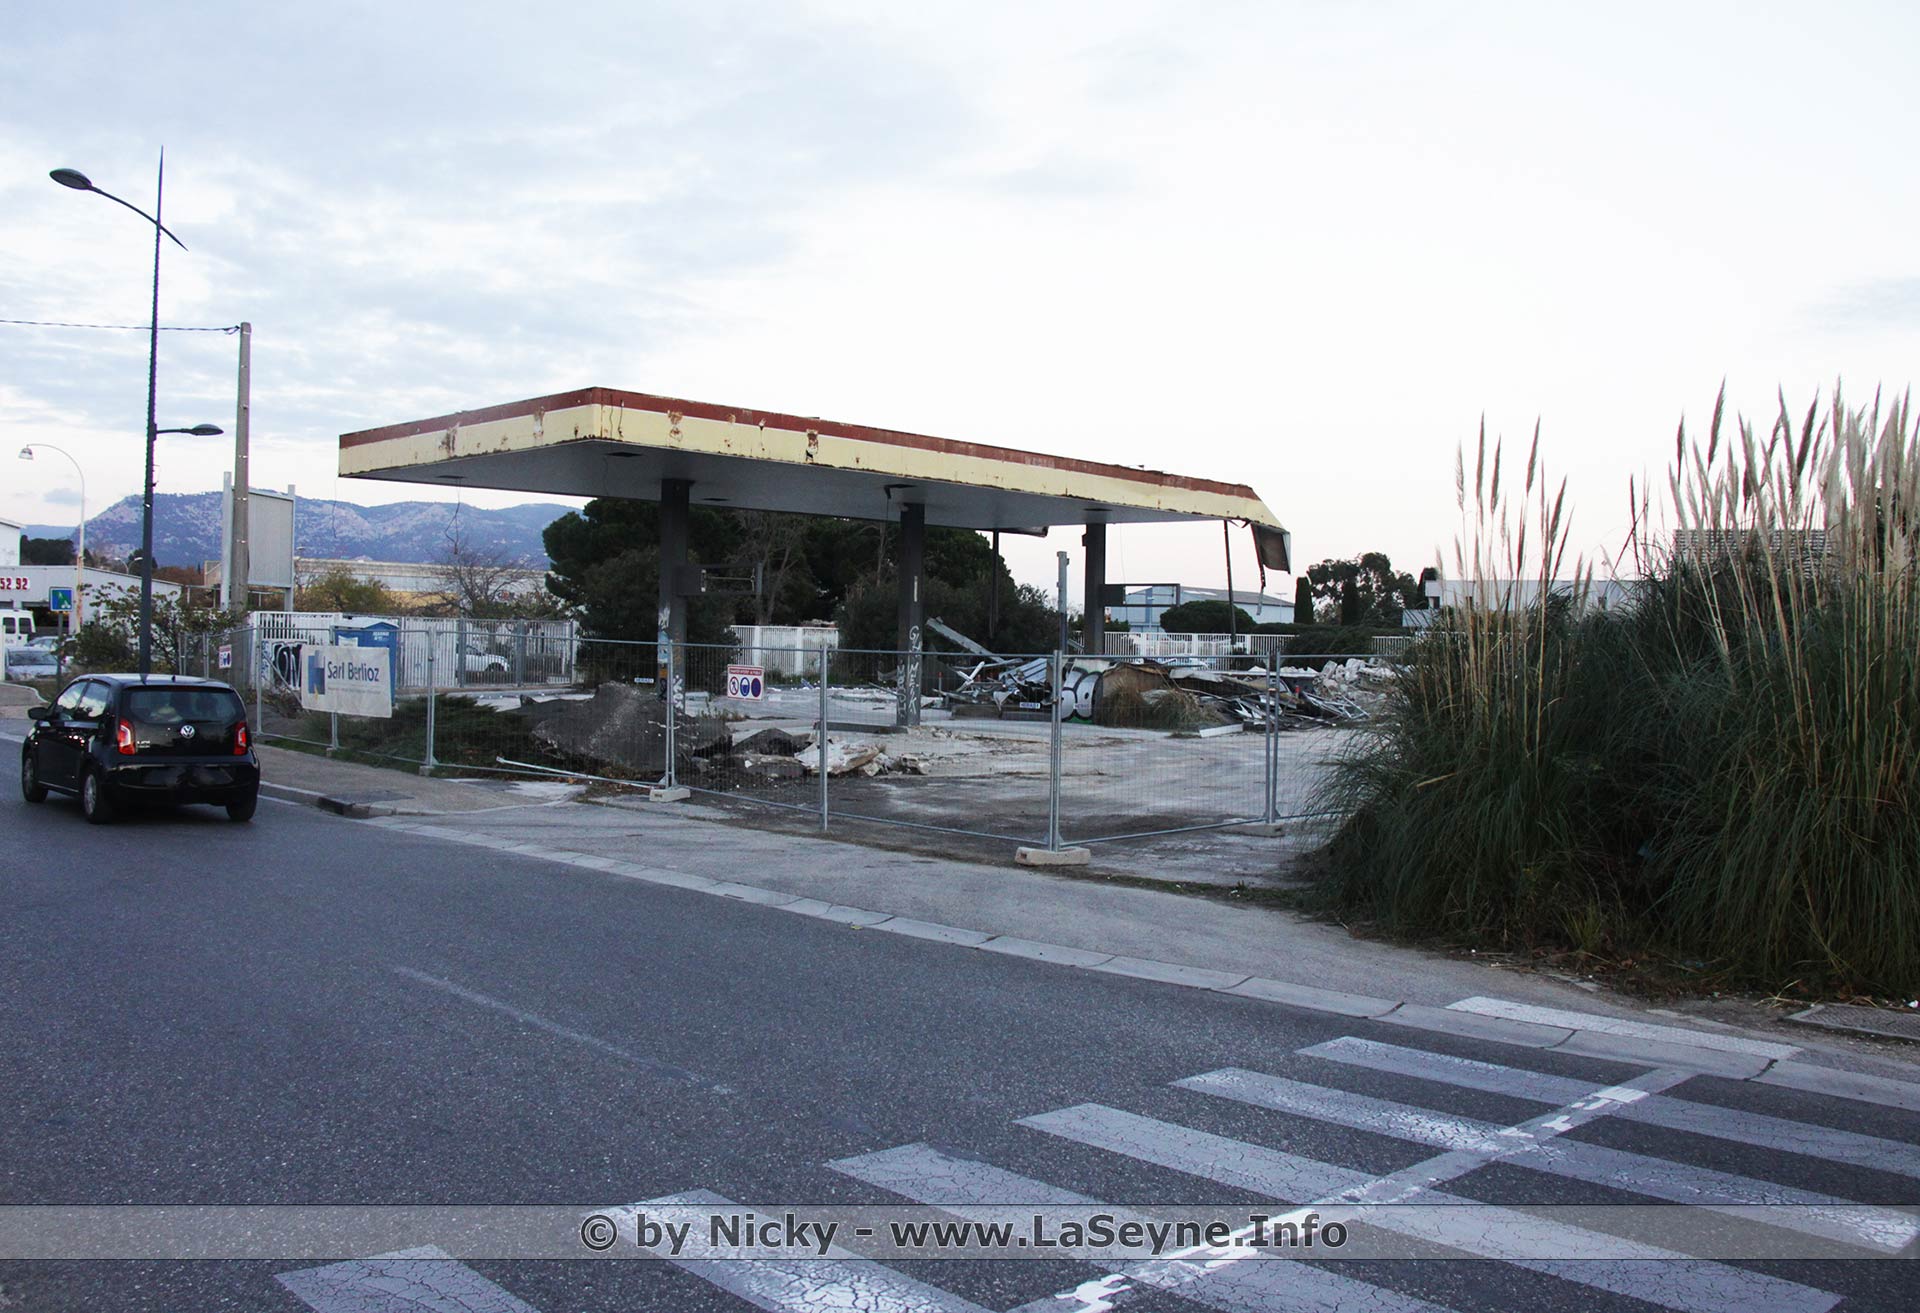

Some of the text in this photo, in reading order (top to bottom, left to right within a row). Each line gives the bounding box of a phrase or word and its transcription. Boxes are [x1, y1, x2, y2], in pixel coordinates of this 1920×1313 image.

[16, 577, 28, 590] 92
[327, 661, 380, 682] Sarl Berlioz
